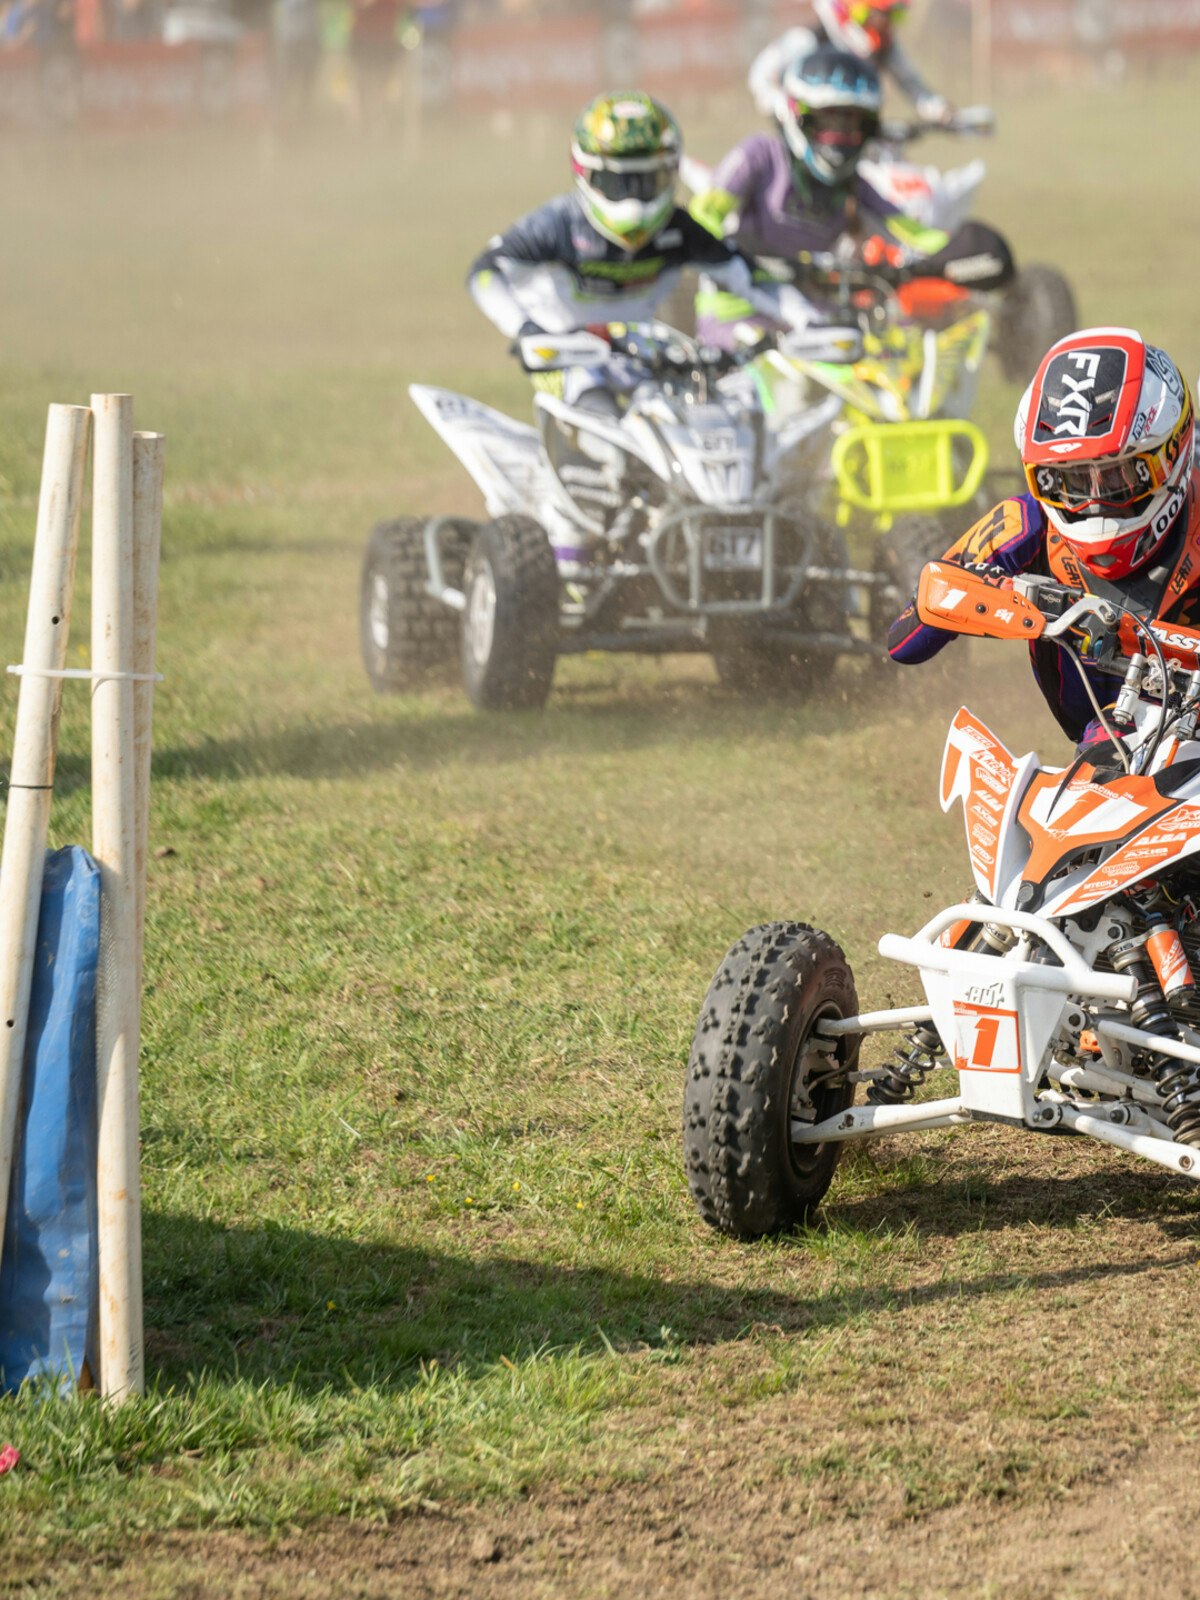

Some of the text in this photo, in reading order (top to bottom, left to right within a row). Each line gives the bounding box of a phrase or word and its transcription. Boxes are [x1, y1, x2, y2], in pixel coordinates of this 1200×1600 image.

[1055, 352, 1101, 436] FXR
[939, 588, 968, 610] 1
[1132, 832, 1188, 848] ALBA
[1123, 847, 1169, 860] AXIS
[972, 1016, 1000, 1068] 1
